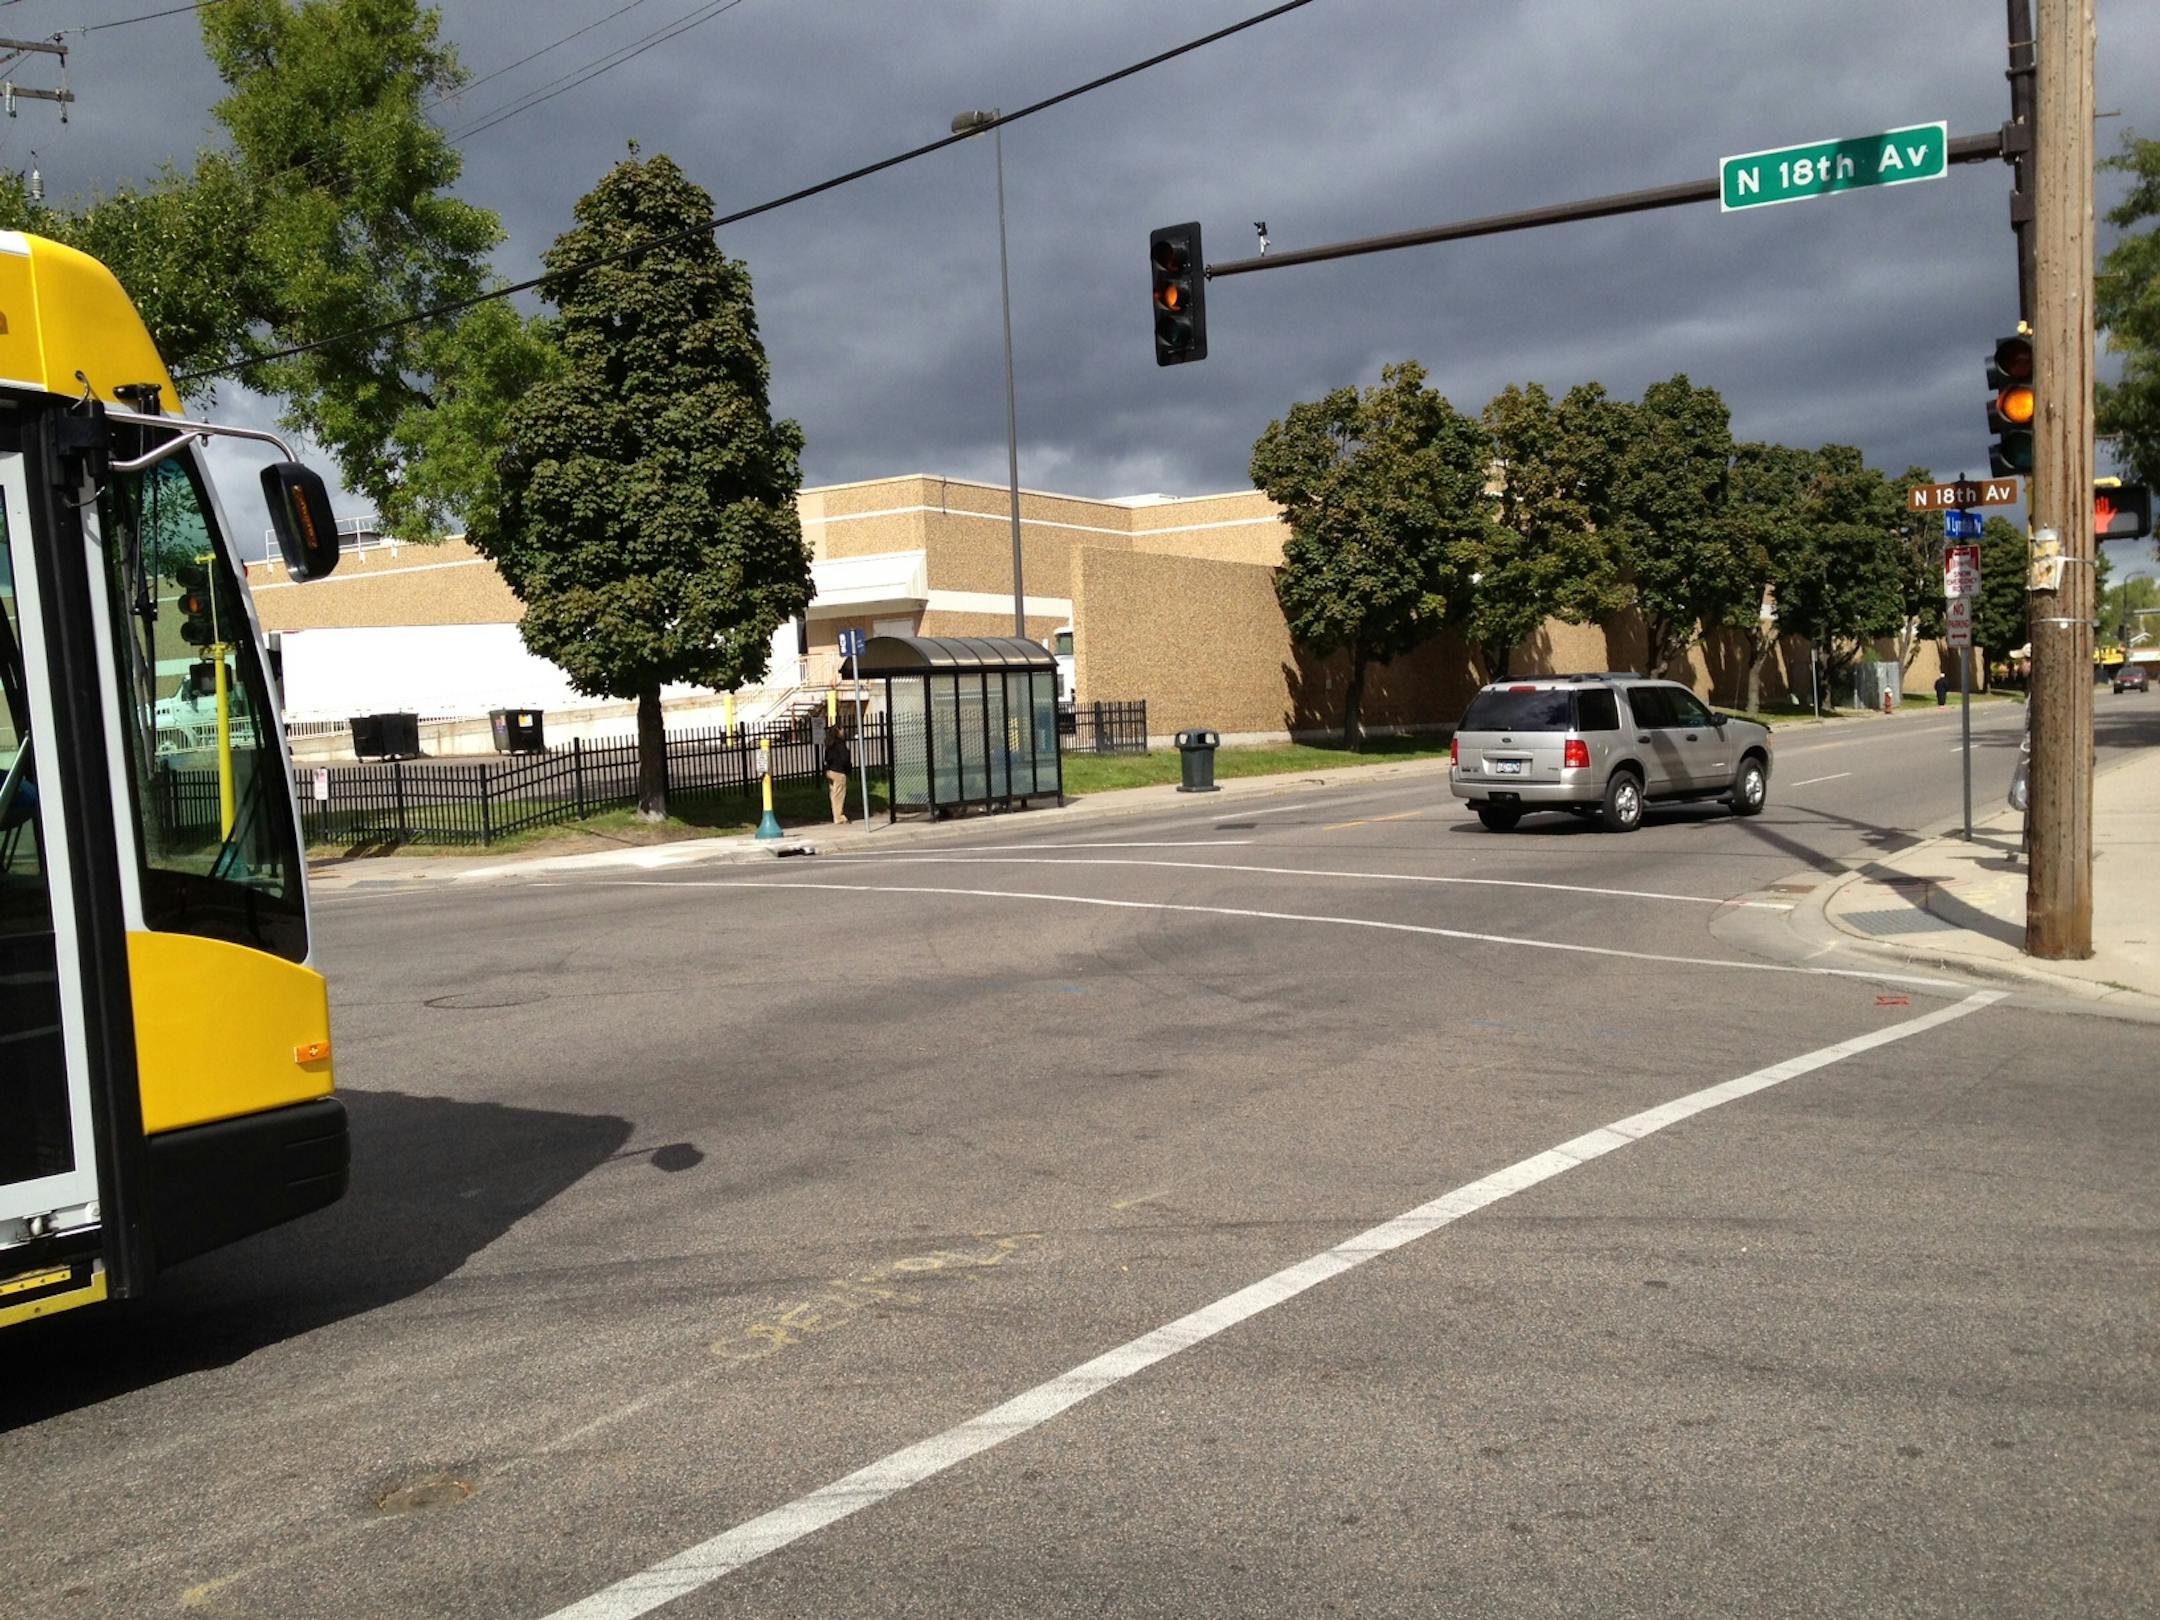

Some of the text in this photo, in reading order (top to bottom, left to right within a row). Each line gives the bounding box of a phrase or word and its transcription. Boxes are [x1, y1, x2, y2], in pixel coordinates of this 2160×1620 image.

[1737, 143, 1929, 196] N 18th Av
[1914, 484, 2011, 507] N 18th Av
[1953, 603, 1965, 616] NO
